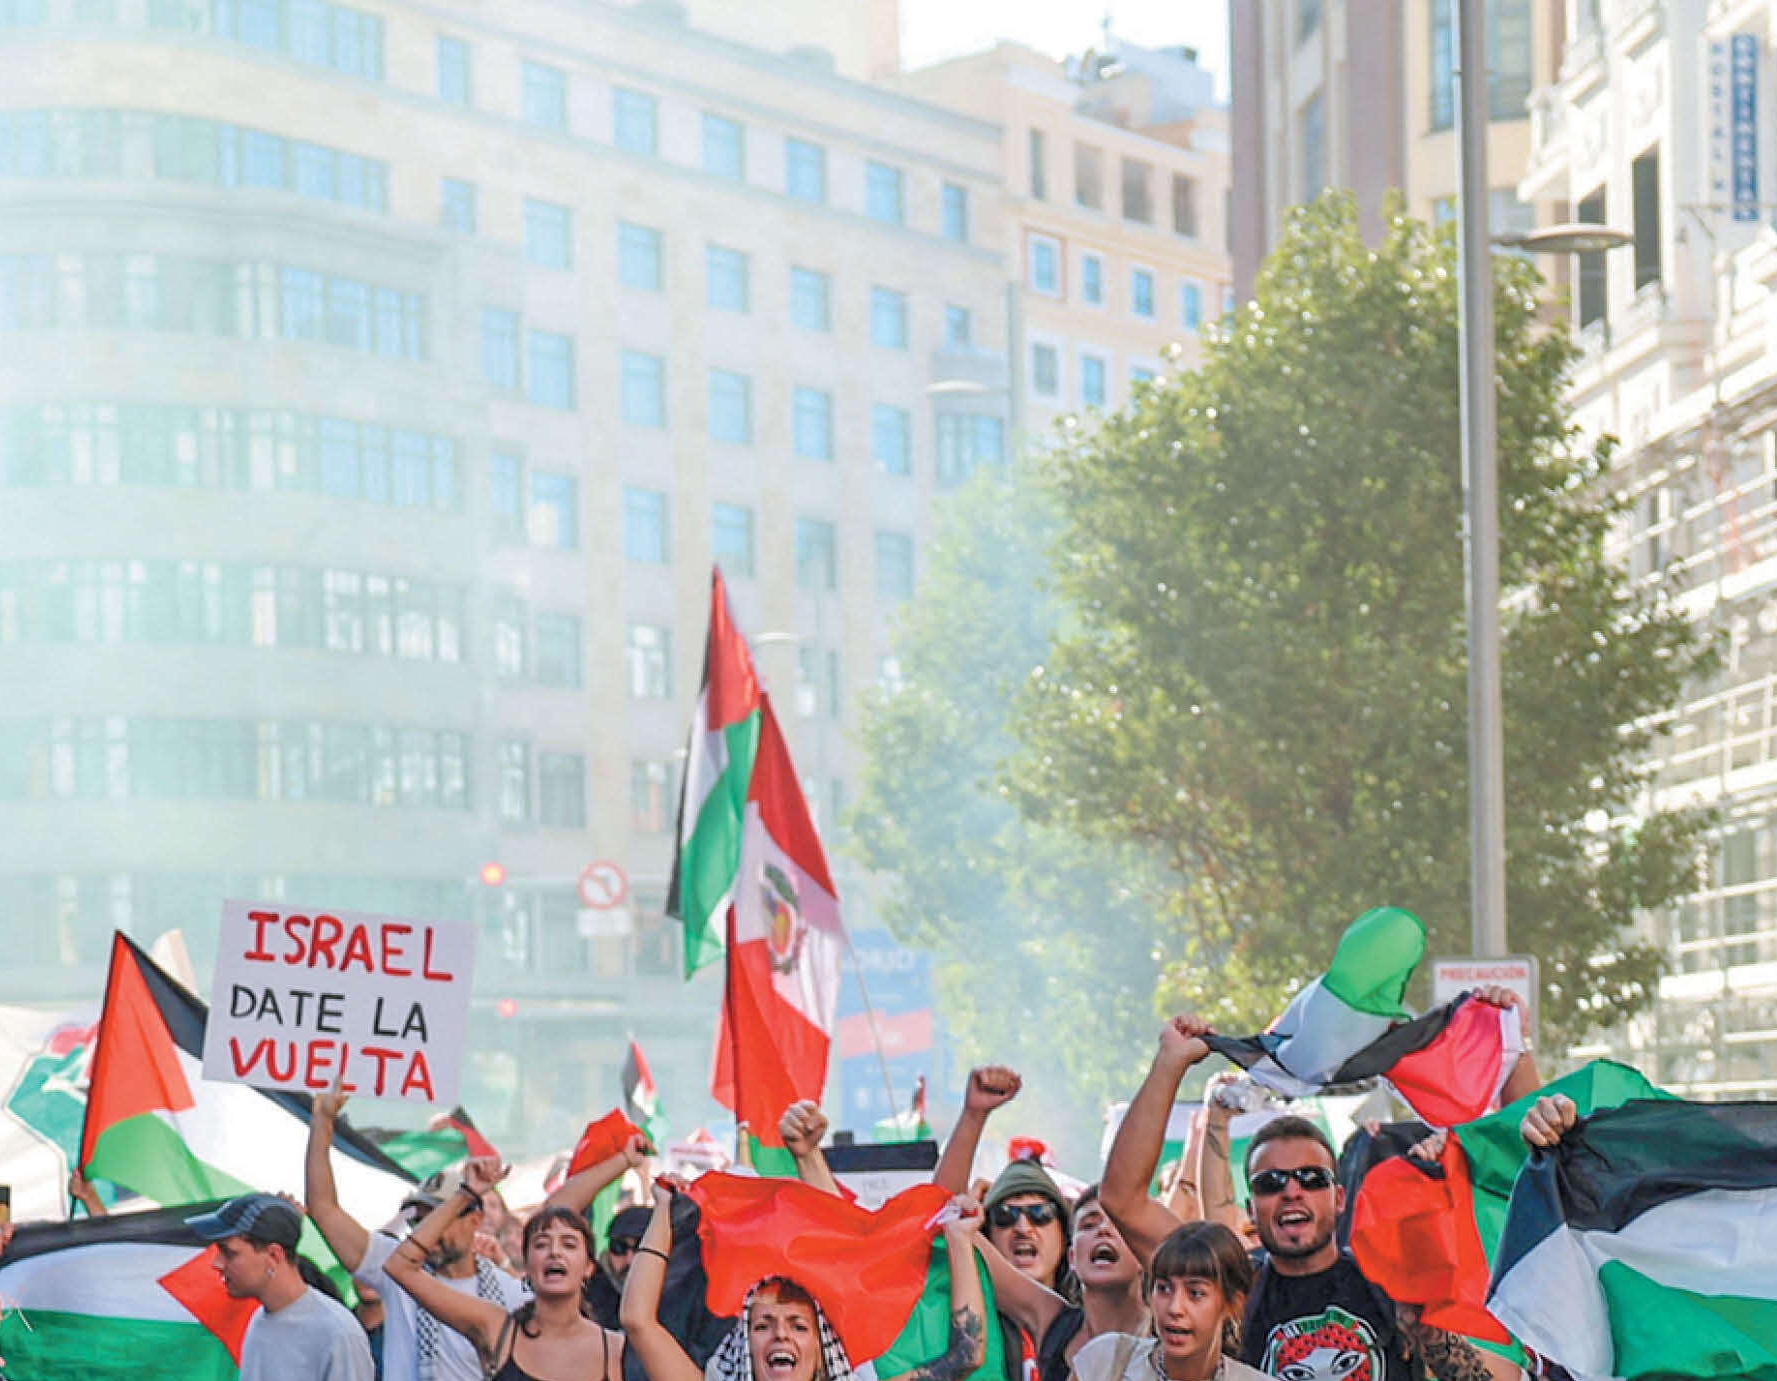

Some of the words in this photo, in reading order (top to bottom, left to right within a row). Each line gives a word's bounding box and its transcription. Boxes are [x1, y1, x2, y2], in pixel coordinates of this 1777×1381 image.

[243, 910, 454, 982] ISRAEL
[230, 983, 346, 1034] DATE
[373, 996, 428, 1044] LA
[229, 1036, 435, 1103] VUELTA
